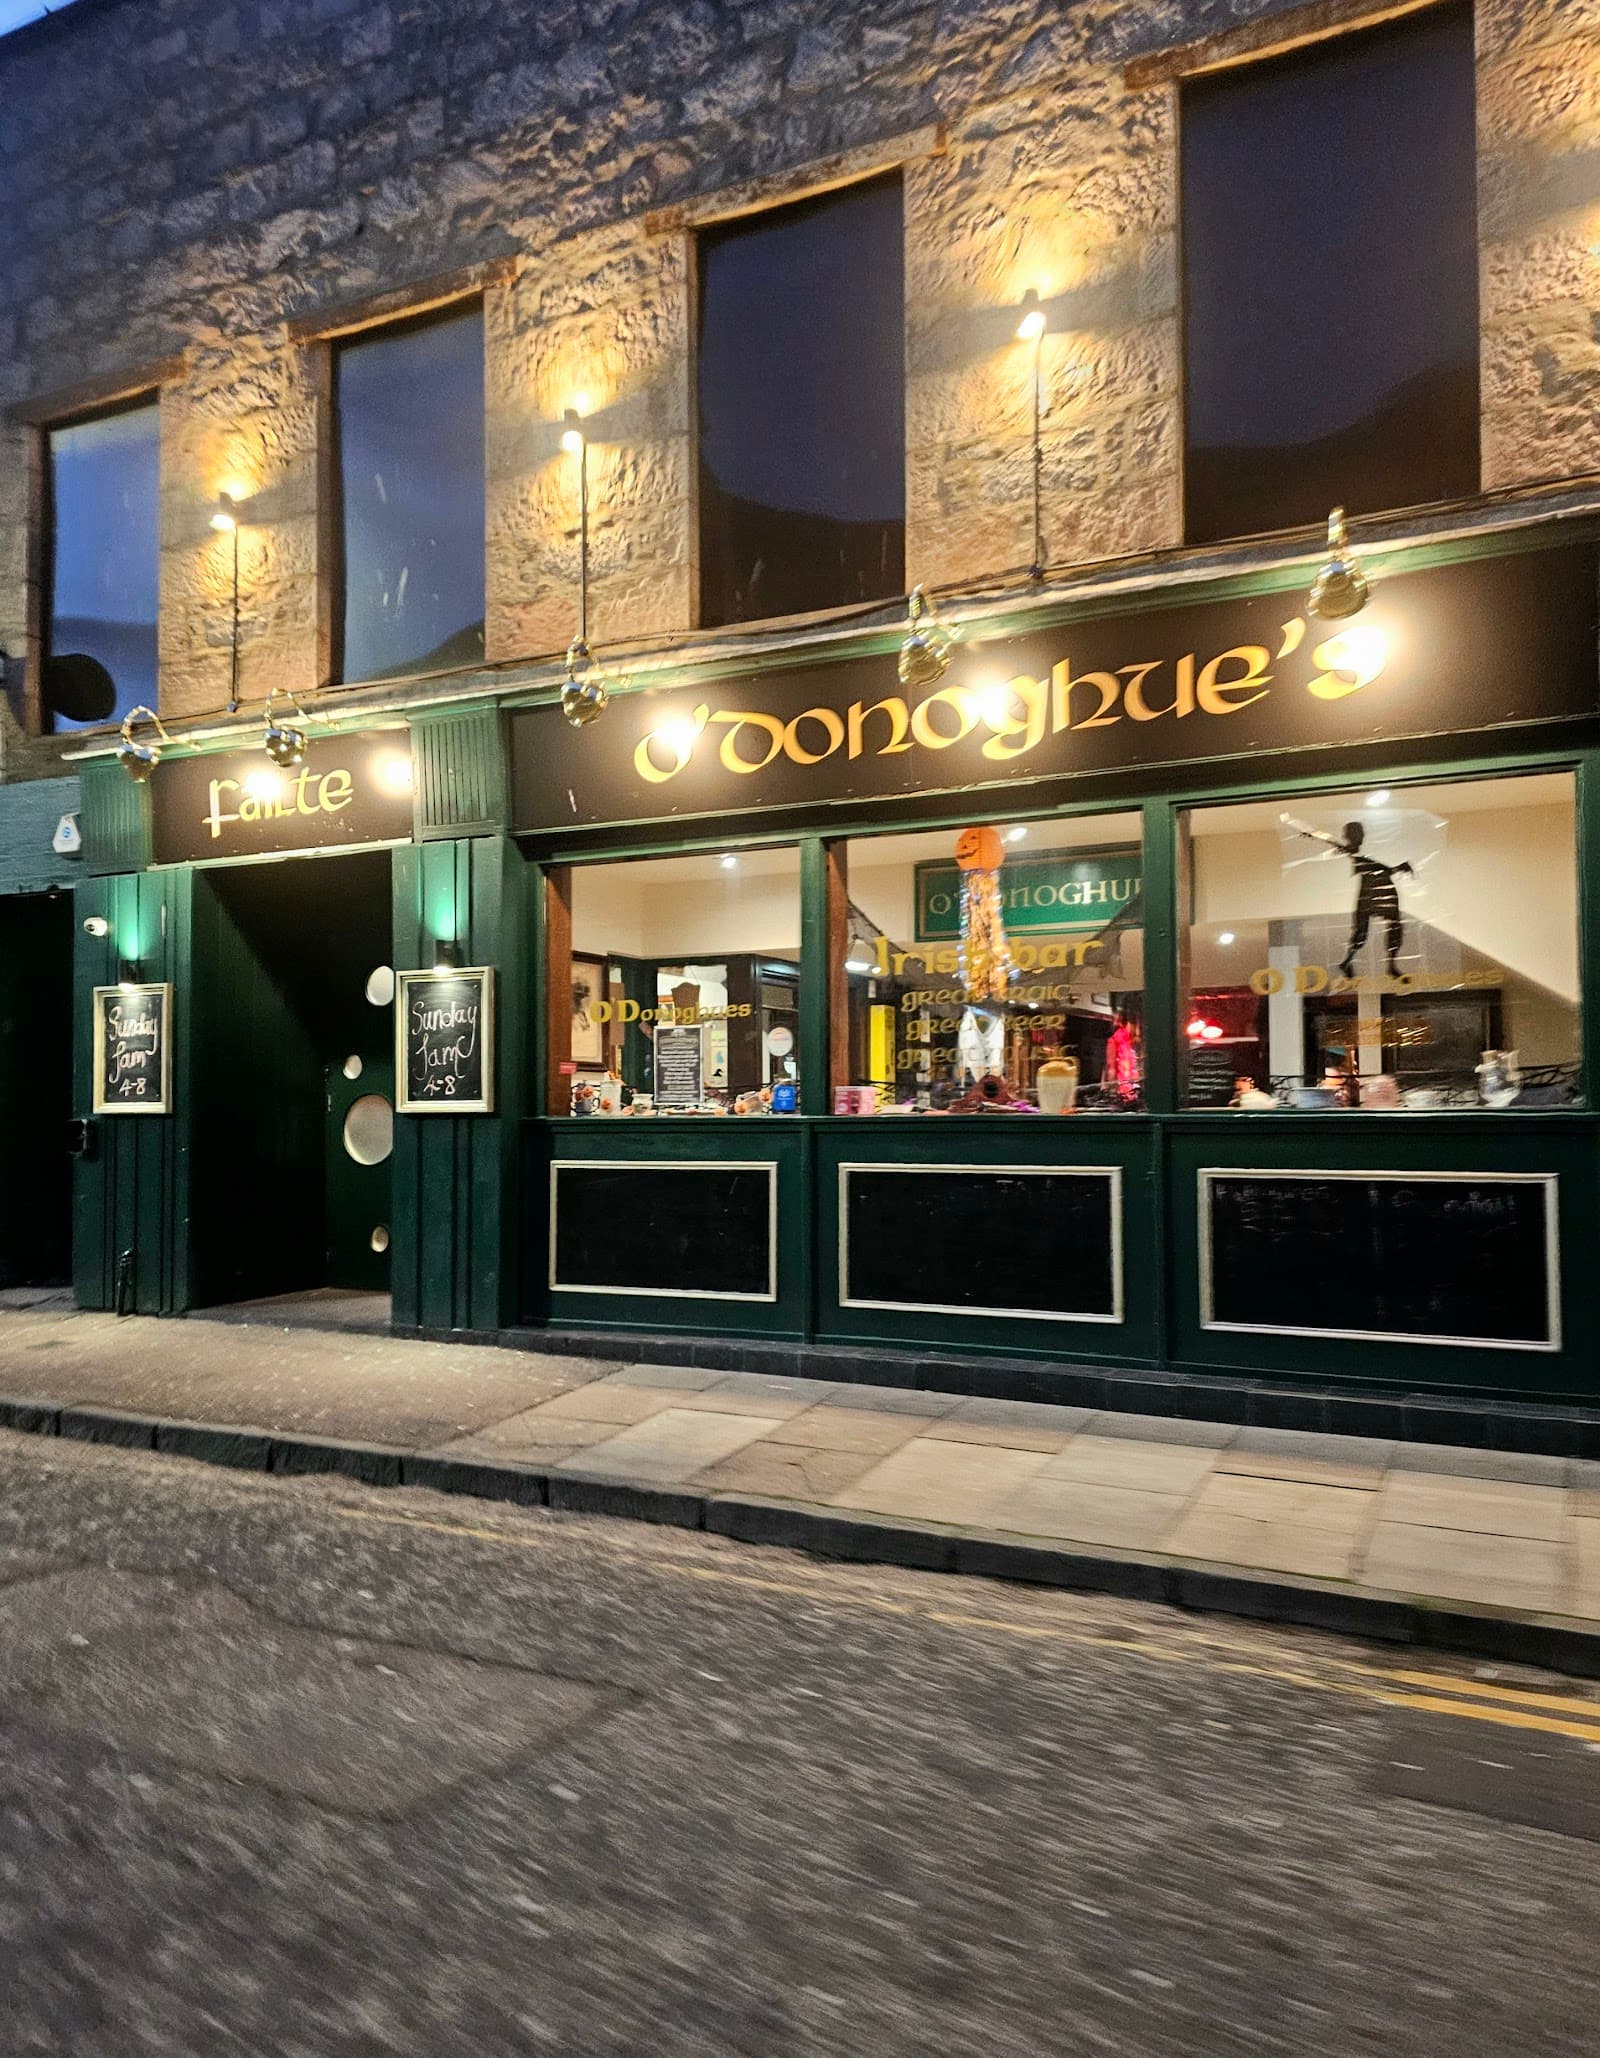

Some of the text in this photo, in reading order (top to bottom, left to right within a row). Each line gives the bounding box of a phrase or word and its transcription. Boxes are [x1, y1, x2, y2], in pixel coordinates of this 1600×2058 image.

[108, 1005, 159, 1056] Sunday
[411, 1001, 478, 1058] Sunday
[119, 1077, 147, 1097] 4-8
[423, 1074, 456, 1097] 4-8
